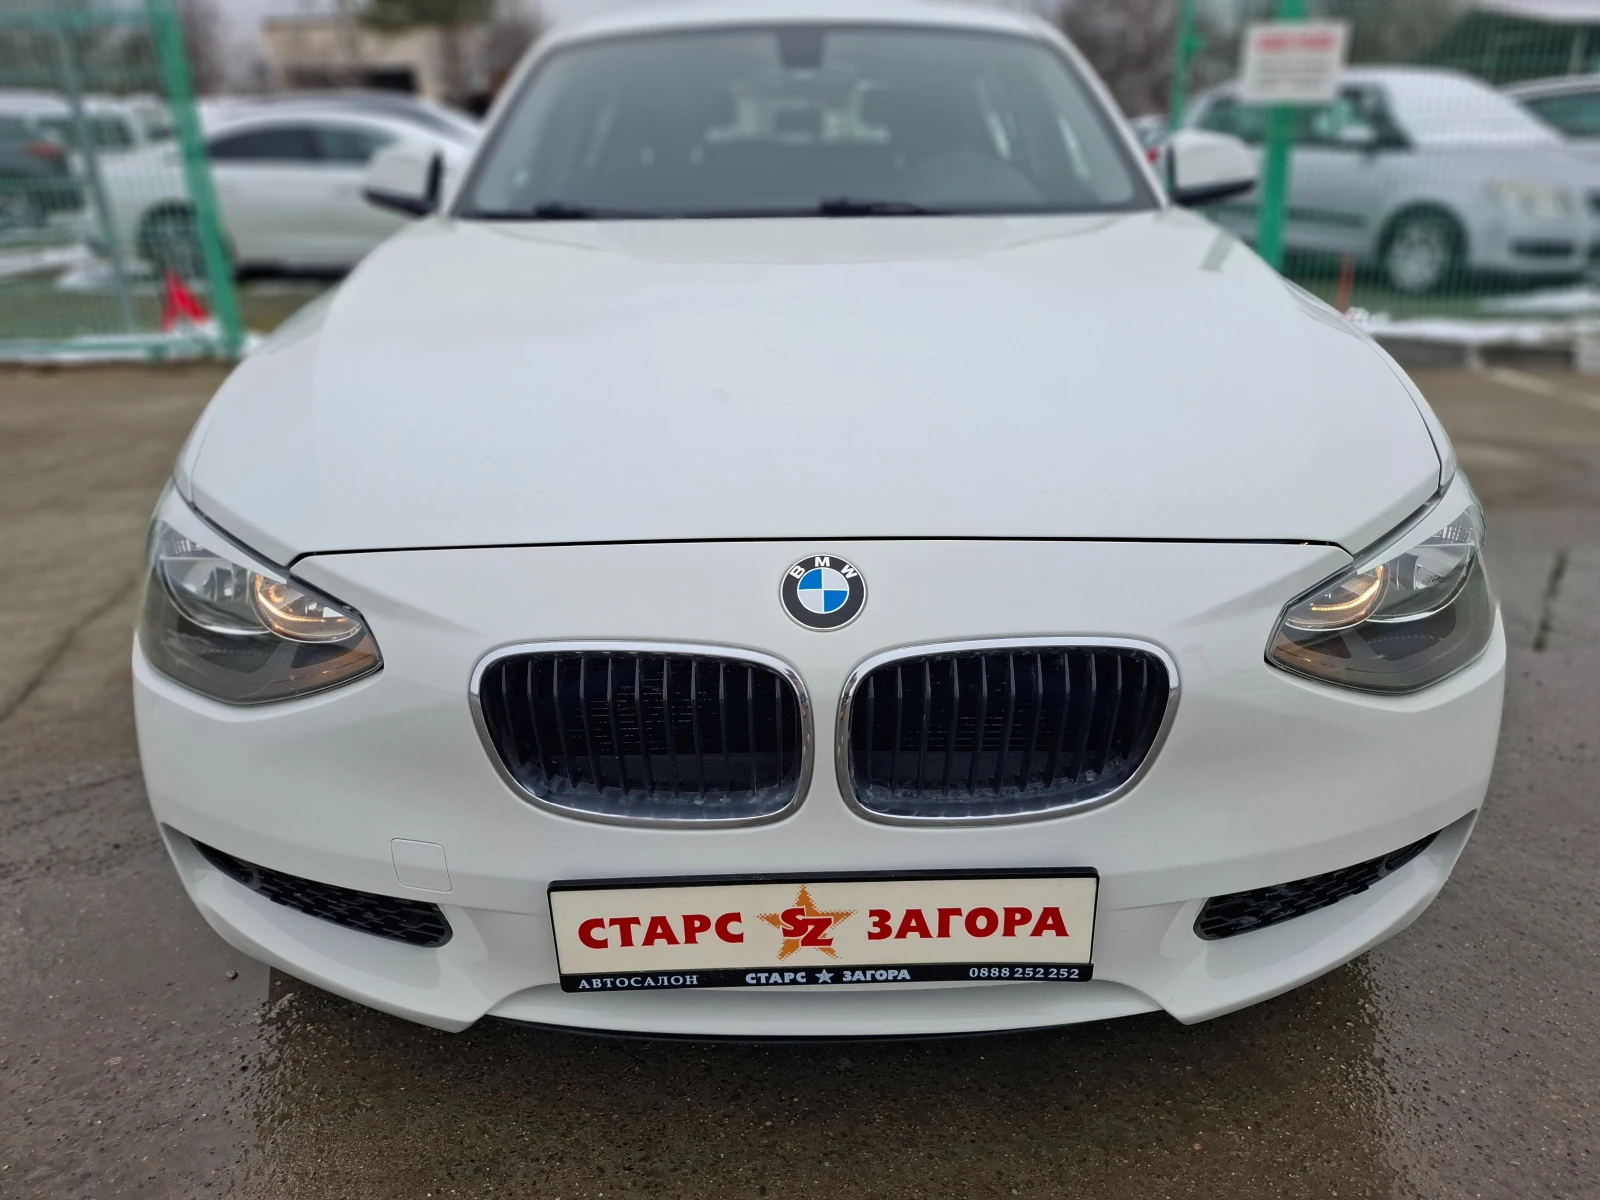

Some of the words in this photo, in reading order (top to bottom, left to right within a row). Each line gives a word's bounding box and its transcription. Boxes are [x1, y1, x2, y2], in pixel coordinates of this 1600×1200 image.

[789, 556, 858, 580] BMW
[577, 911, 744, 950] СТАРС
[780, 907, 834, 948] SZ
[867, 906, 1070, 940] ЗАГОРА
[578, 974, 699, 989] АВТОСАЛОН
[745, 971, 807, 984] СТАРС
[842, 969, 911, 982] ЗАГОРА
[969, 967, 1010, 978] 0888
[1013, 967, 1045, 978] 252
[1047, 968, 1079, 978] 252
